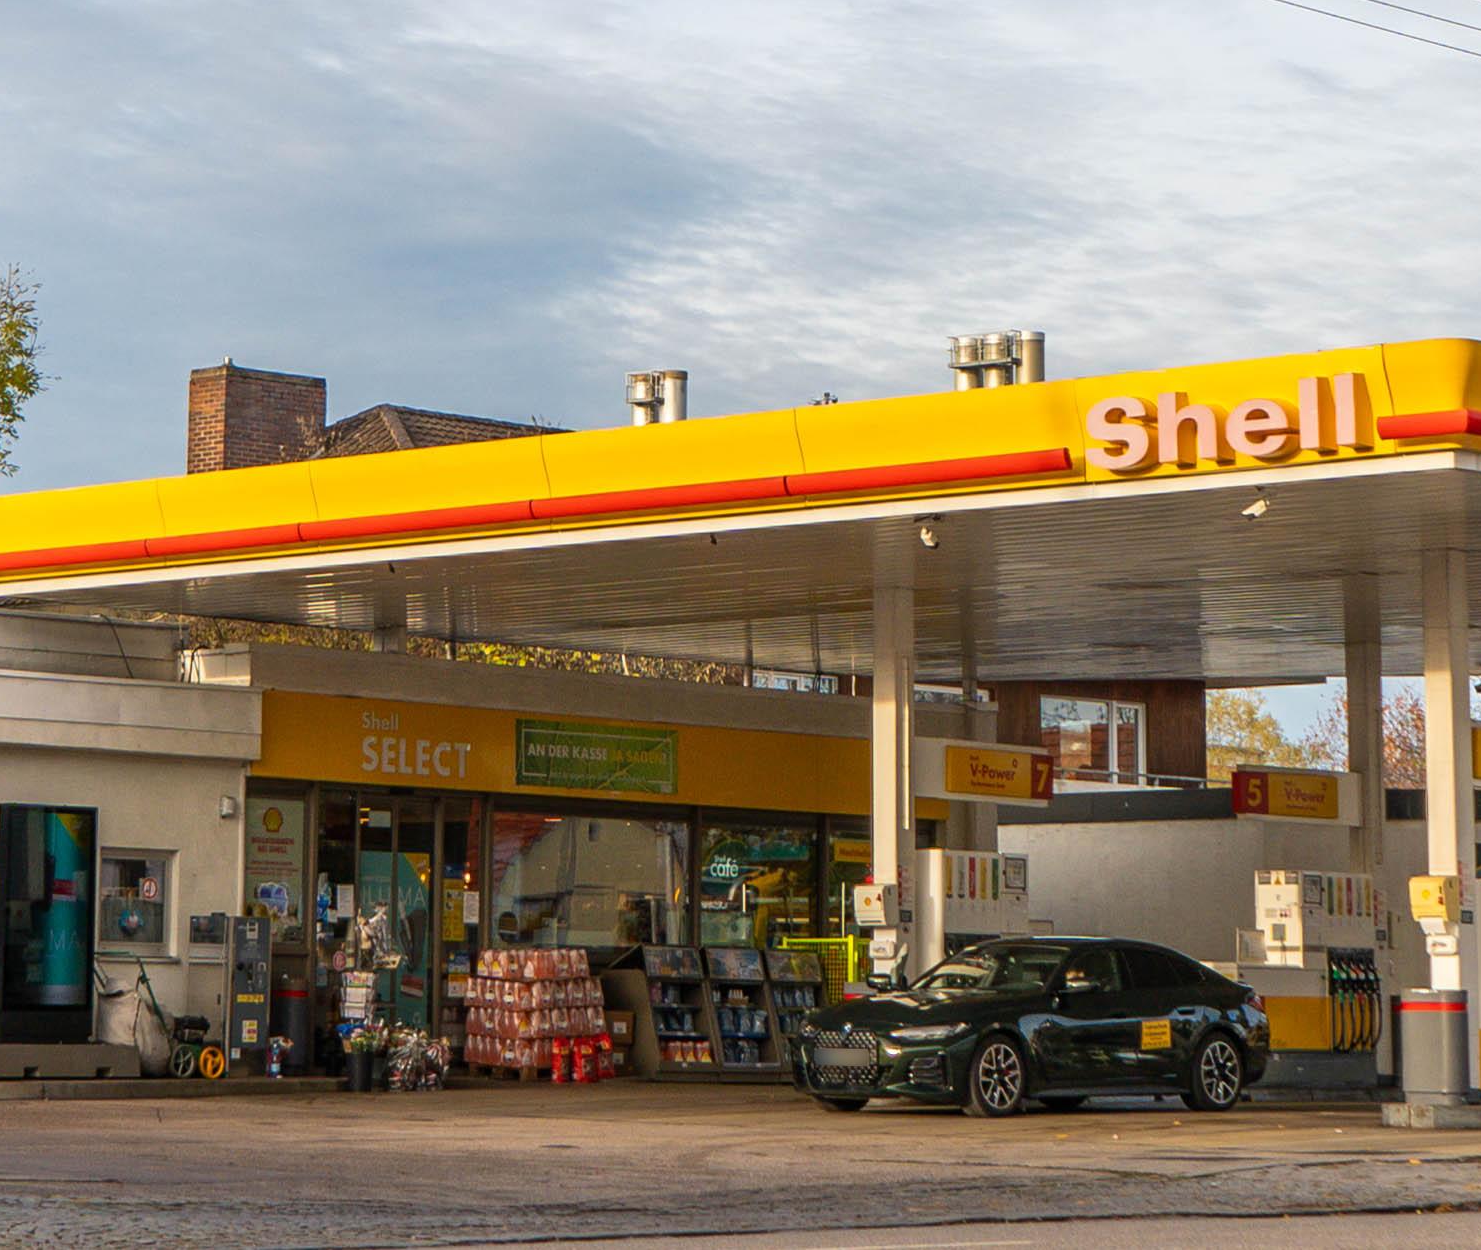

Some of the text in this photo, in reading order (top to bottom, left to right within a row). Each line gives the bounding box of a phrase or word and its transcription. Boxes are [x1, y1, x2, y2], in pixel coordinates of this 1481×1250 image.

[1085, 372, 1361, 472] Shell
[362, 711, 399, 731] Shell
[361, 736, 471, 779] SELECT
[527, 743, 546, 757] AN
[548, 744, 569, 759] DER
[572, 746, 608, 761] KASSE
[970, 763, 1016, 781] V-Power
[1036, 762, 1049, 793] 7
[1247, 778, 1262, 807] 5
[709, 857, 739, 878] café
